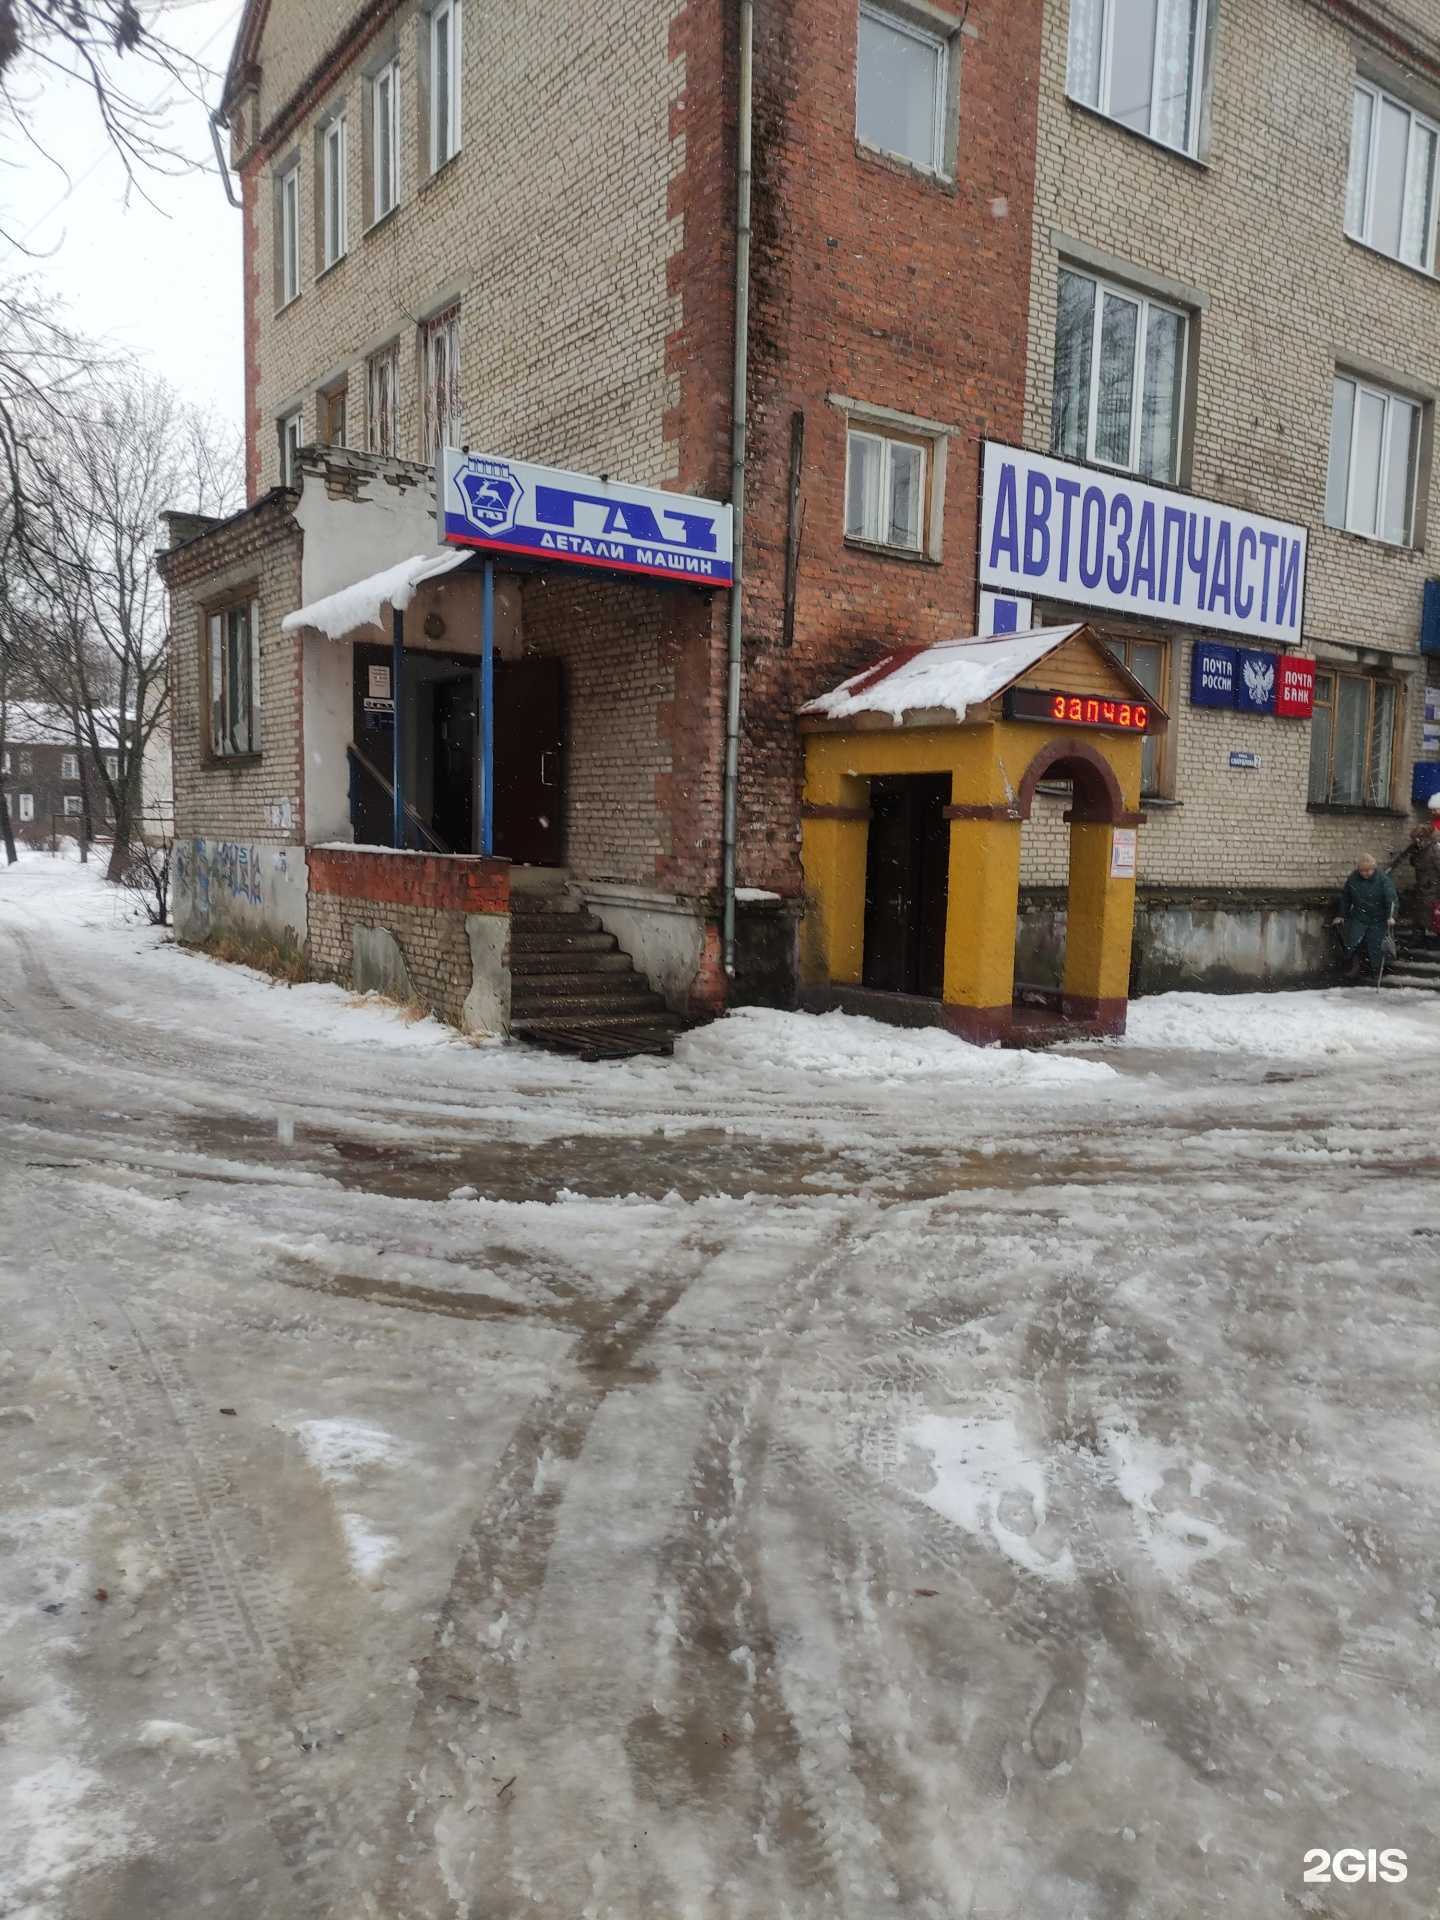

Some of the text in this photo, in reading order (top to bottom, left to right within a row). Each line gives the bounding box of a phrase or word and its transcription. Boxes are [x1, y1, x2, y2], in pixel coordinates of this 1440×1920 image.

[535, 485, 718, 553] ГАЗ
[540, 532, 712, 574] ДЕТАЛИ МАШИН
[989, 463, 1300, 628] АВТОЗАПЧАСТИ
[1203, 658, 1232, 676] ПОЧТА
[1285, 671, 1312, 688] ПОЧТА
[1202, 674, 1232, 691] РОССИИ
[1284, 687, 1309, 704] БАНК
[1054, 696, 1147, 728] запчас
